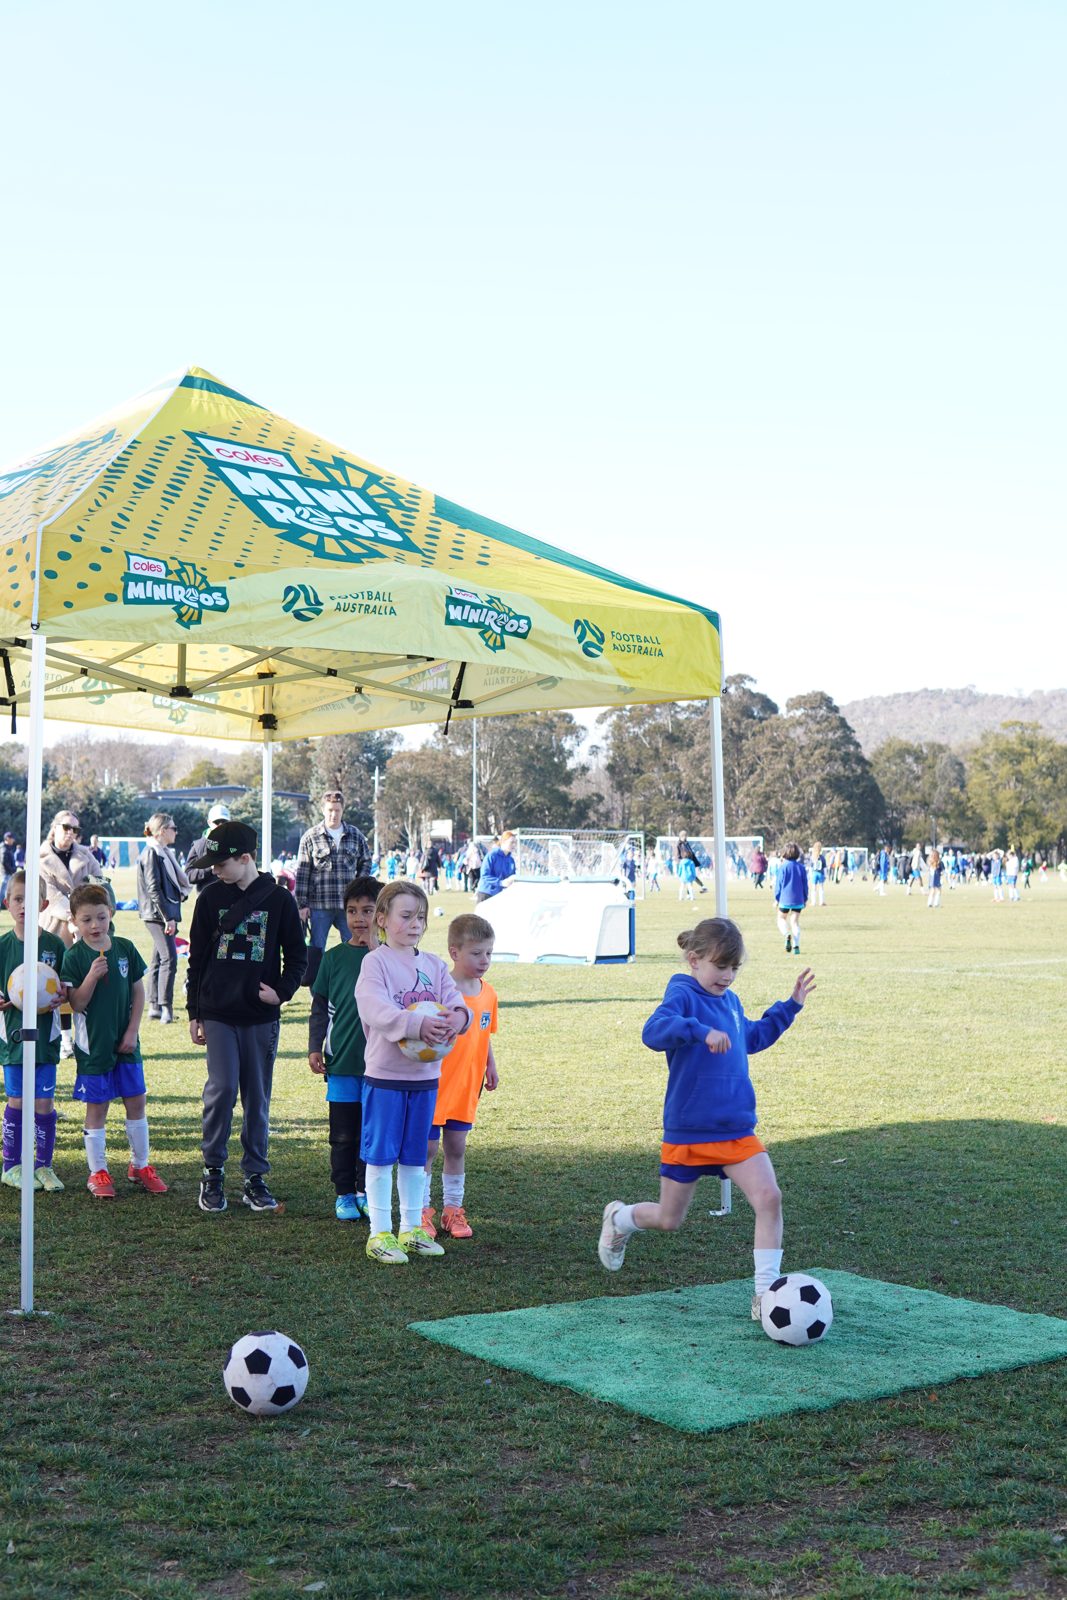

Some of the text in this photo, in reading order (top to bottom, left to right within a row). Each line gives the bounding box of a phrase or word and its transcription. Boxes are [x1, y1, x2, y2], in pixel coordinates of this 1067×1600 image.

[215, 447, 284, 468] coles
[218, 466, 378, 517] MINI
[256, 498, 403, 542] ROOS
[133, 561, 163, 573] coles
[127, 580, 227, 609] MINIROOS
[333, 601, 397, 616] AUSTRALIA
[448, 604, 529, 634] MINIROOS
[610, 630, 661, 645] FOOTBALL
[612, 643, 664, 658] AUSTRALIA
